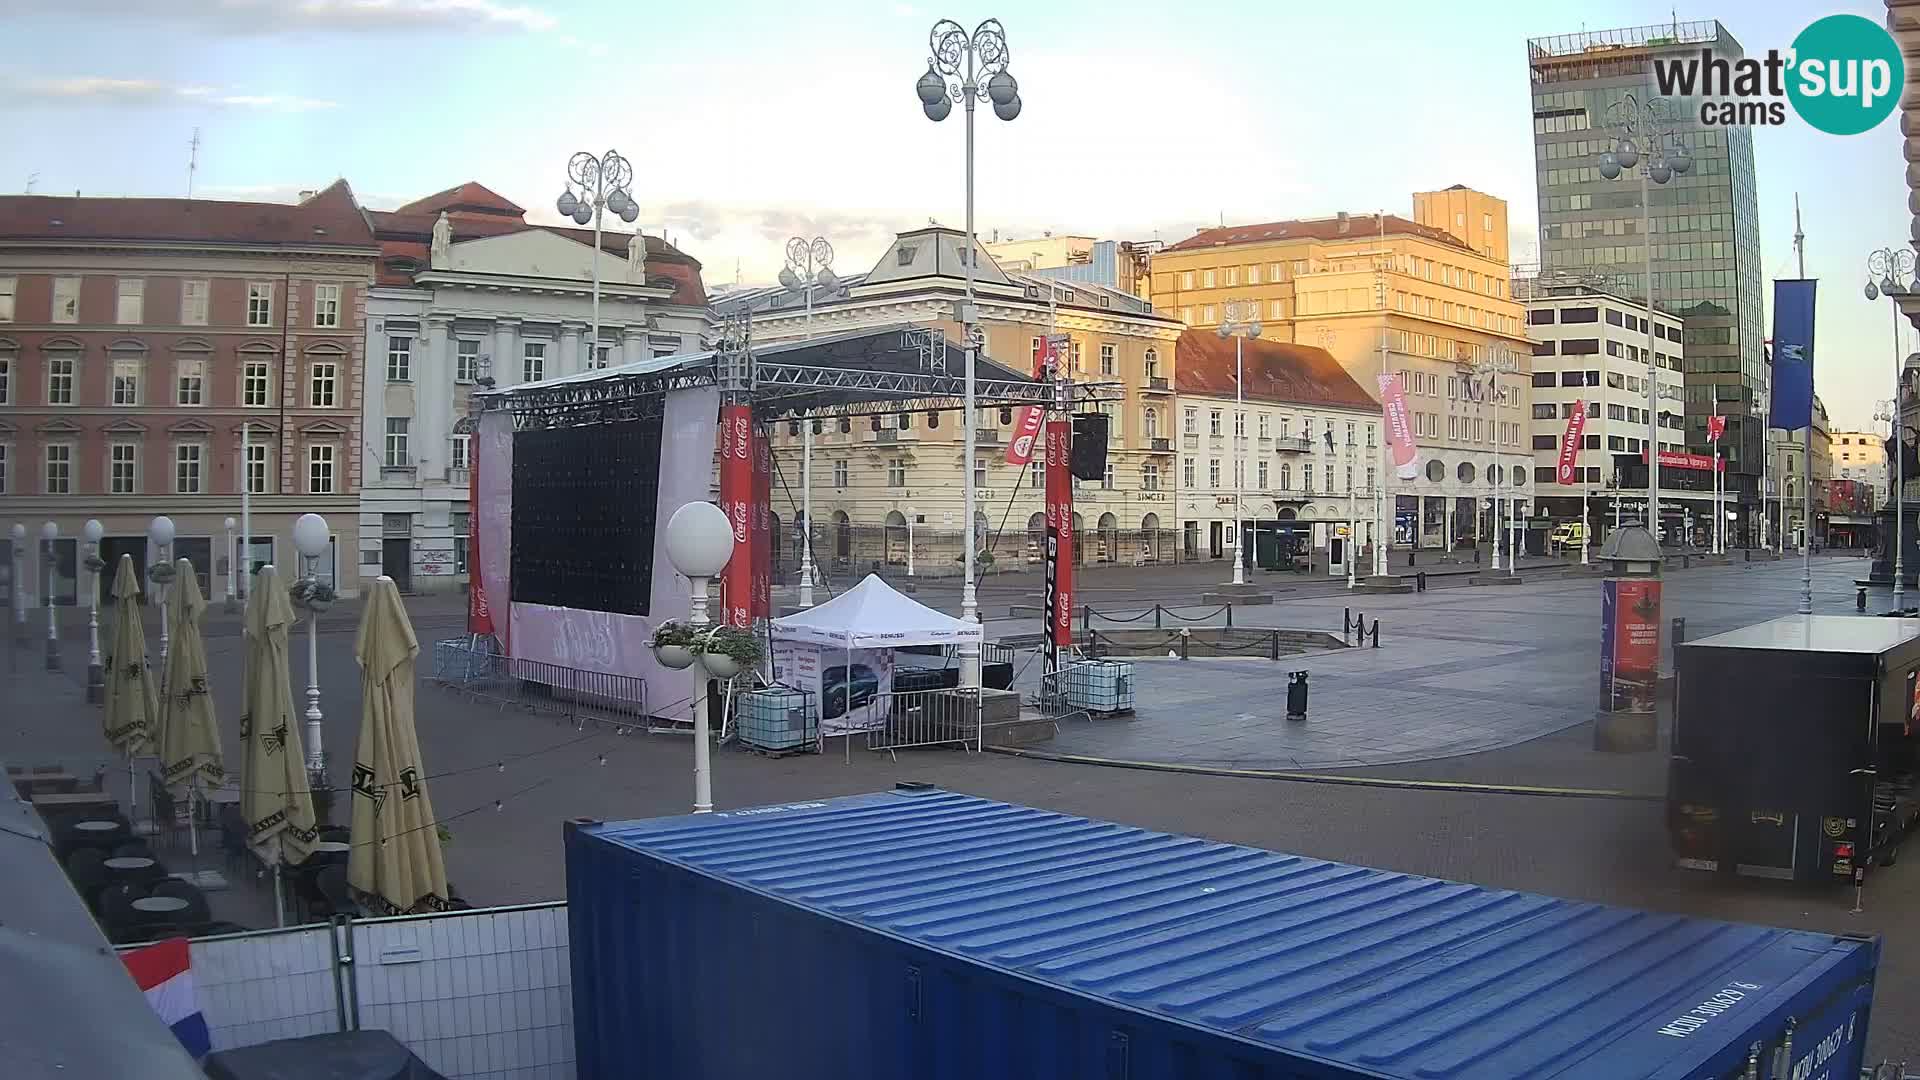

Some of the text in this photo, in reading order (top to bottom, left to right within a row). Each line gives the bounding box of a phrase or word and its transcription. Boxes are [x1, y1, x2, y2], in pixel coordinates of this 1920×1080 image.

[1564, 412, 1582, 461] MI HRVATI
[1137, 493, 1166, 501] SINGER
[1657, 1014, 1708, 1038] MCDU
[1692, 988, 1746, 1017] 300629
